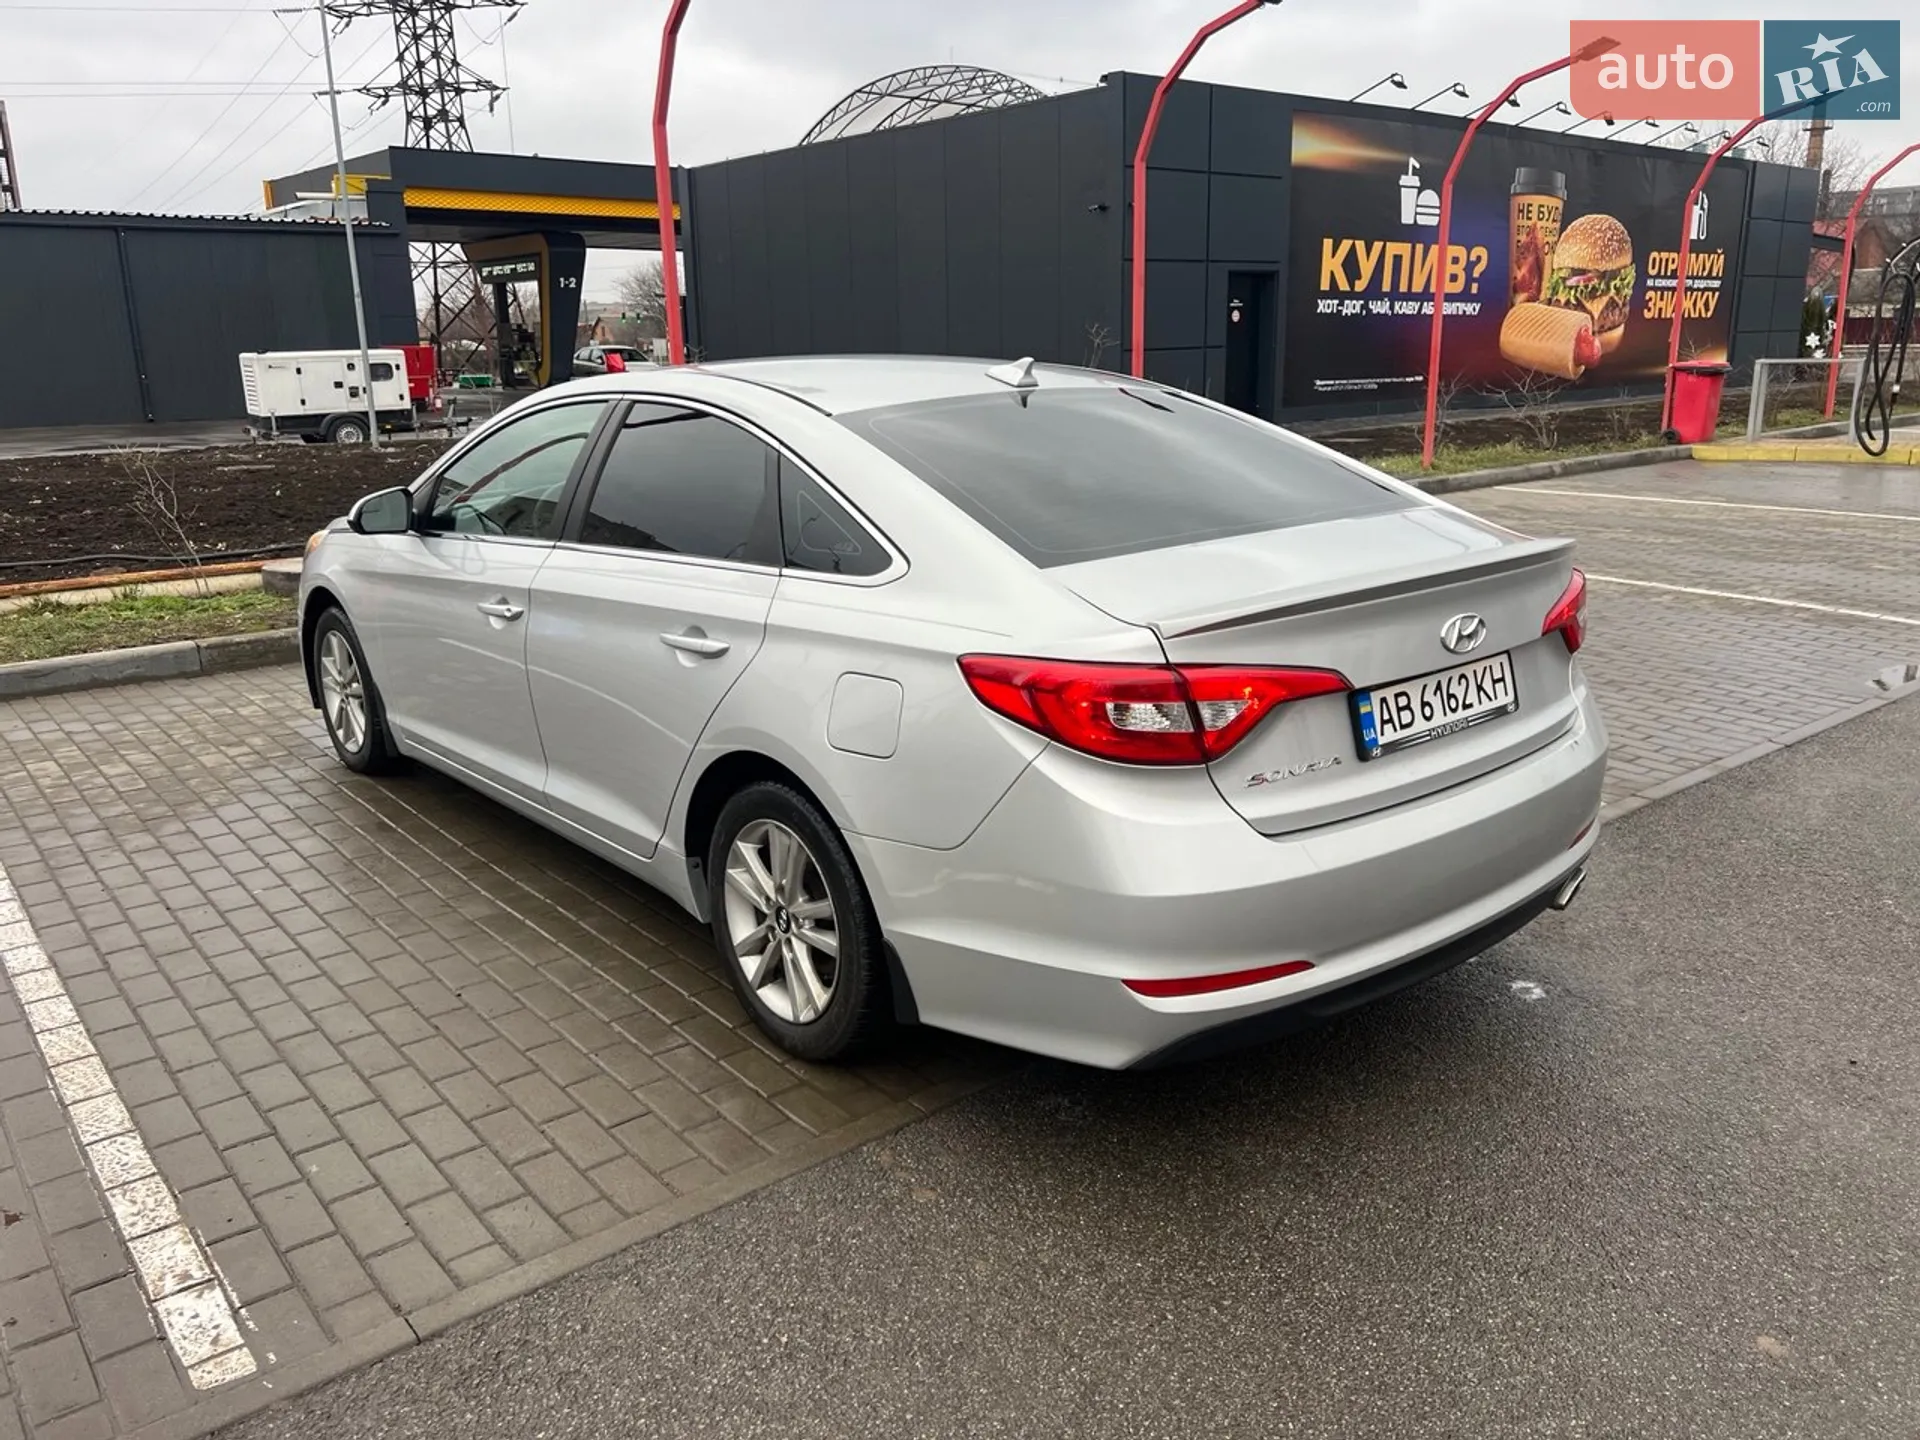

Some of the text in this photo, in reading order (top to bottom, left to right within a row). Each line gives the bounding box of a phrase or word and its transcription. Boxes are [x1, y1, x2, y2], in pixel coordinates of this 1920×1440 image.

[1517, 202, 1533, 221] НЕ
[1320, 238, 1488, 294] КУПИВ?
[1369, 298, 1392, 316] ЧАЙ,
[1394, 301, 1419, 315] КАВУ
[1379, 661, 1509, 736] AB 6162 KH
[1363, 727, 1377, 741] UA
